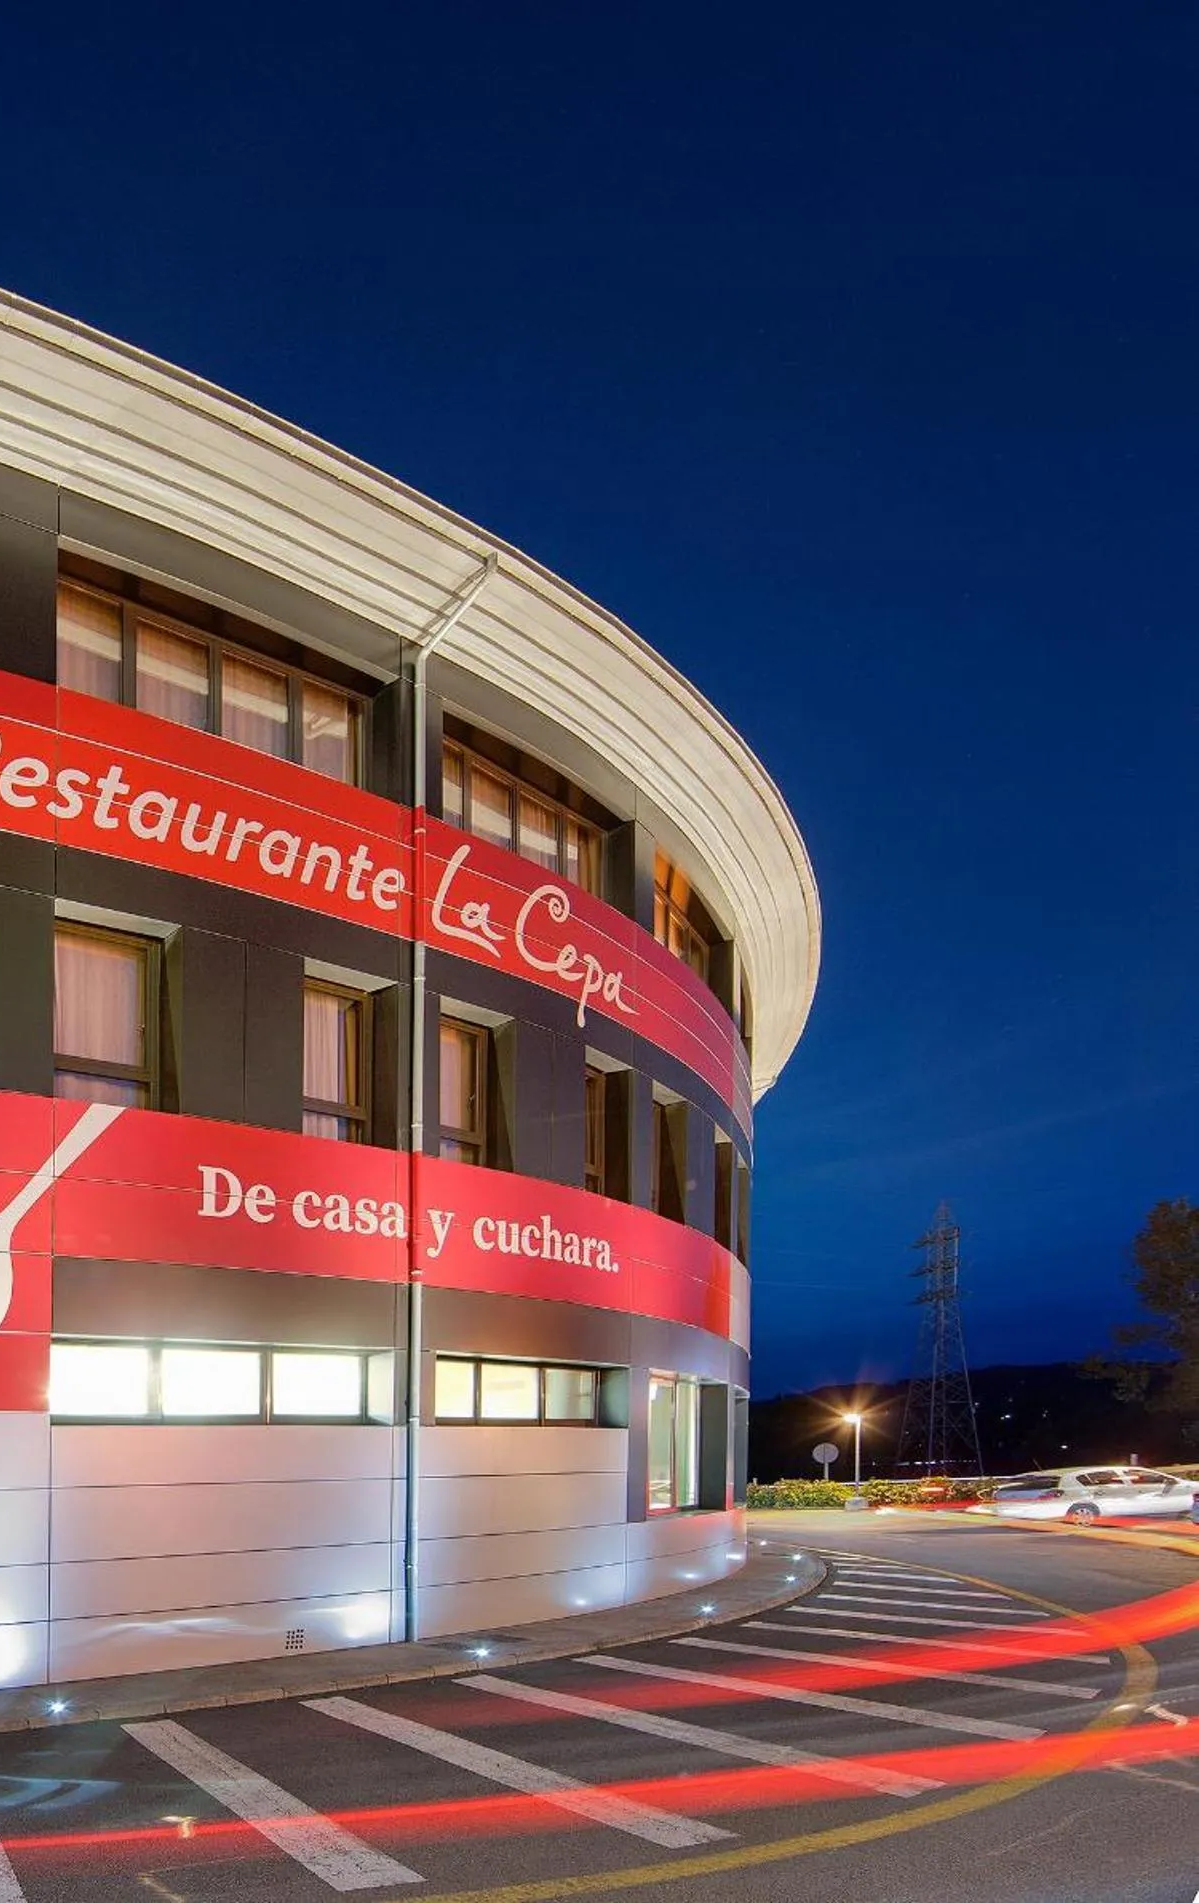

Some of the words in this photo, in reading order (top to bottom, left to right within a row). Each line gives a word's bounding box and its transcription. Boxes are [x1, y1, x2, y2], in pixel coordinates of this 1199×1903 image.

[432, 844, 506, 959] La
[515, 884, 641, 1028] Cepa
[197, 1164, 276, 1223] De
[292, 1190, 408, 1239] casa
[426, 1206, 456, 1258] y
[472, 1214, 620, 1273] cuchara.
